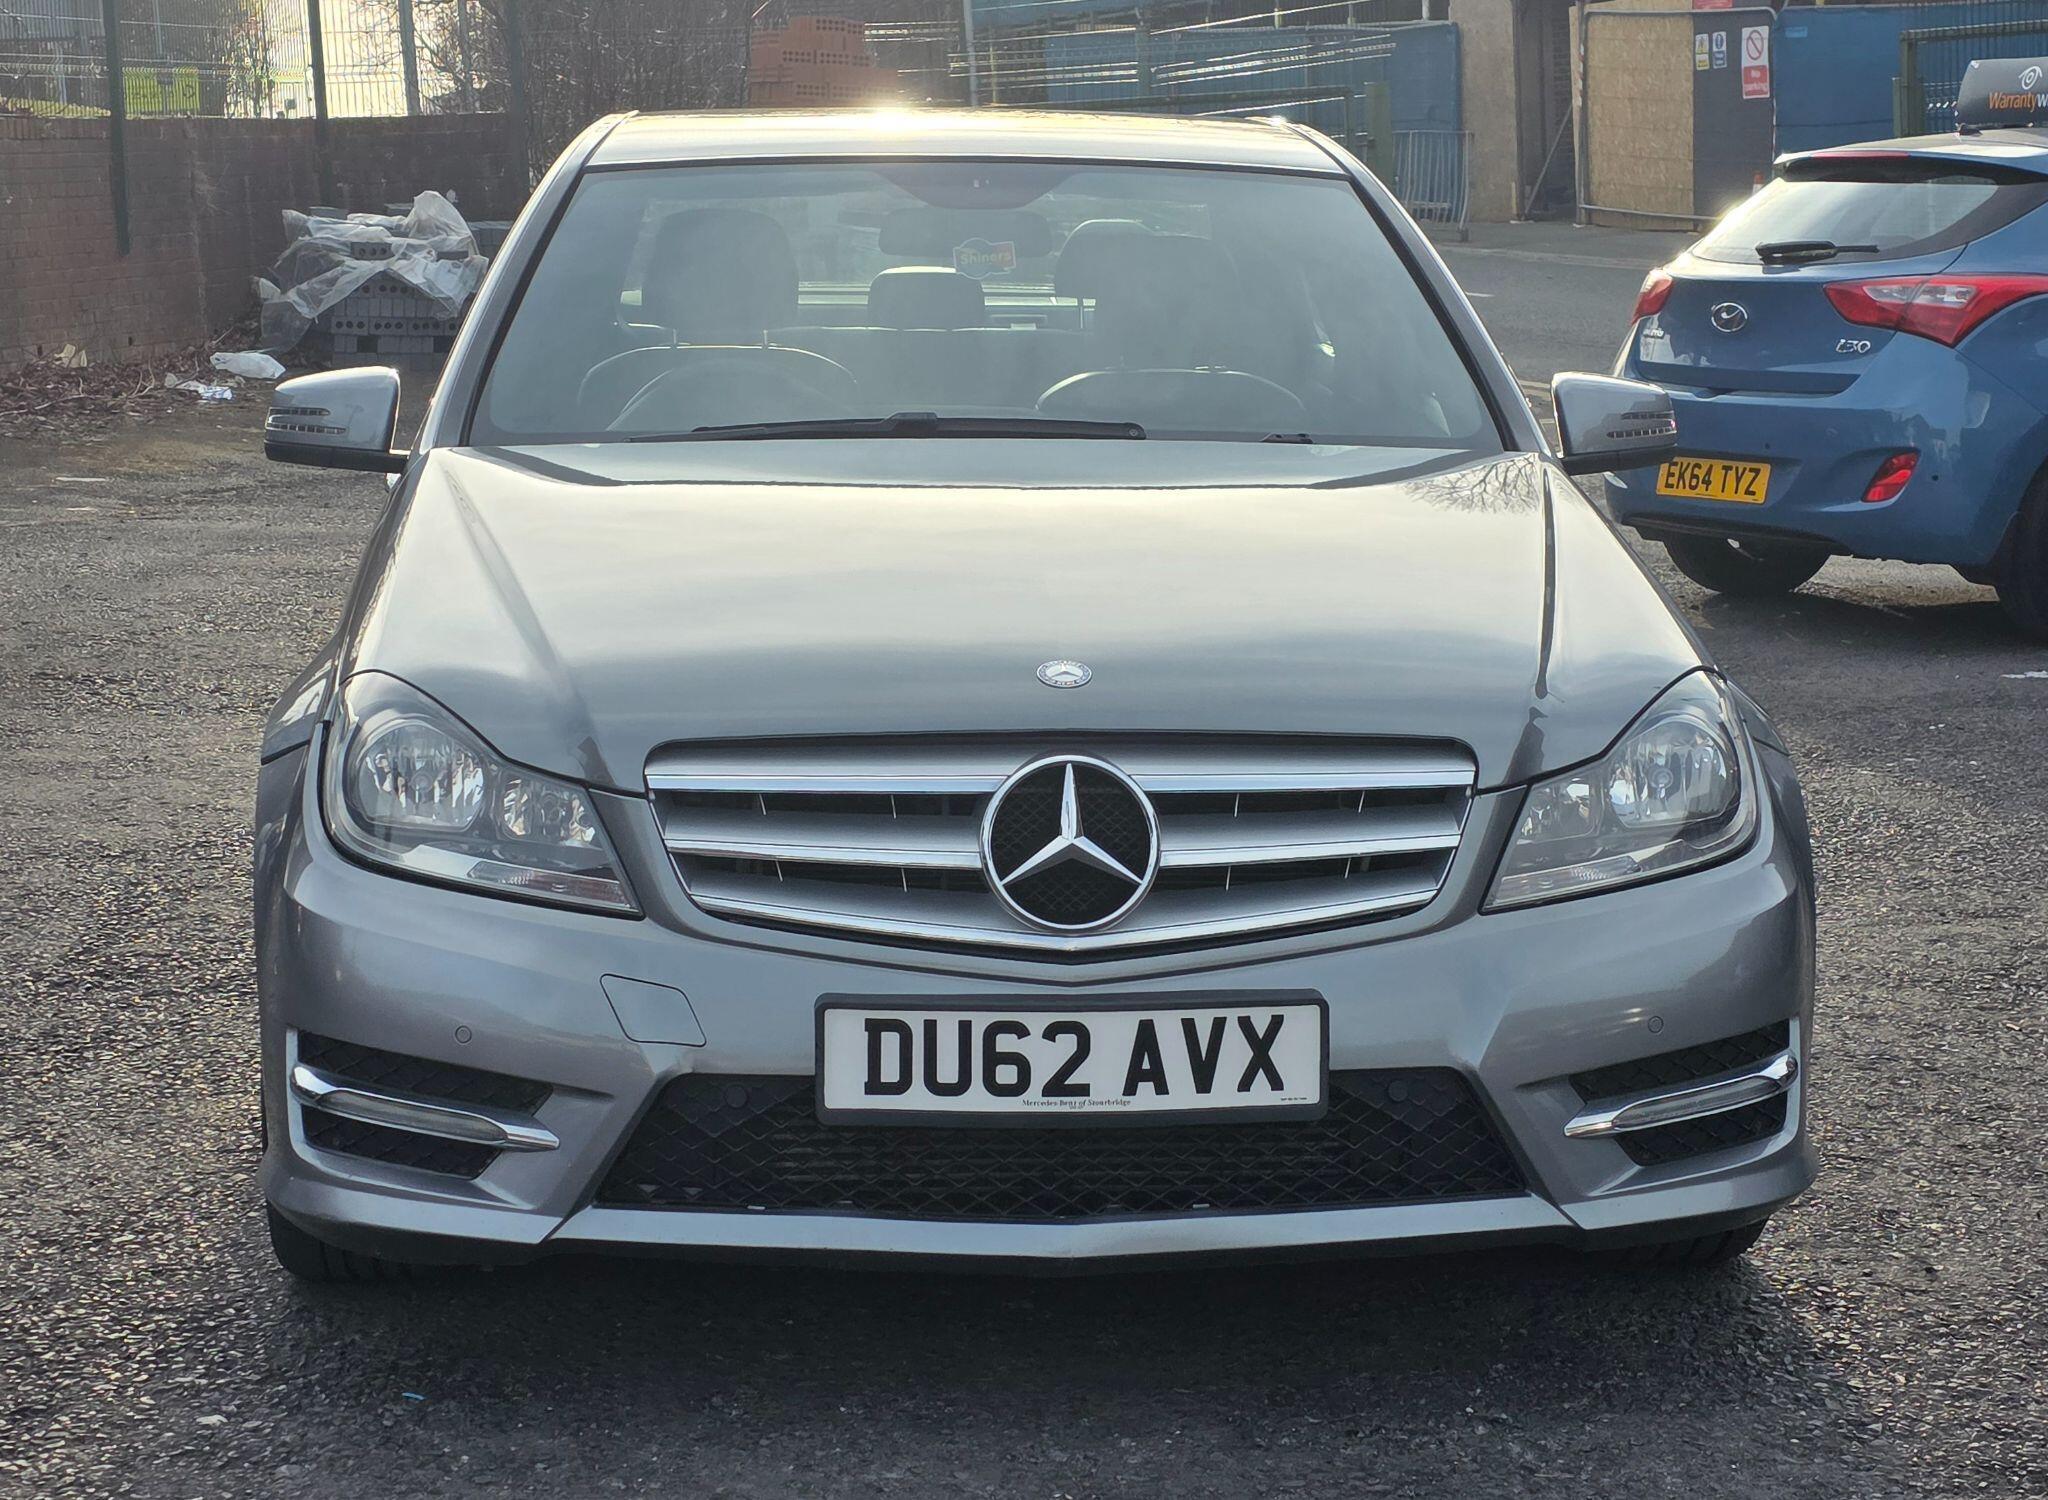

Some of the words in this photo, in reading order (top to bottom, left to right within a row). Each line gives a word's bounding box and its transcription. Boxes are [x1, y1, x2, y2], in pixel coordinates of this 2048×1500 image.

[1836, 338, 1870, 353] i30
[1664, 461, 1714, 492] EK64
[1721, 465, 1761, 496] TYZ
[864, 1018, 1091, 1098] DU62
[1122, 1014, 1285, 1096] AVX
